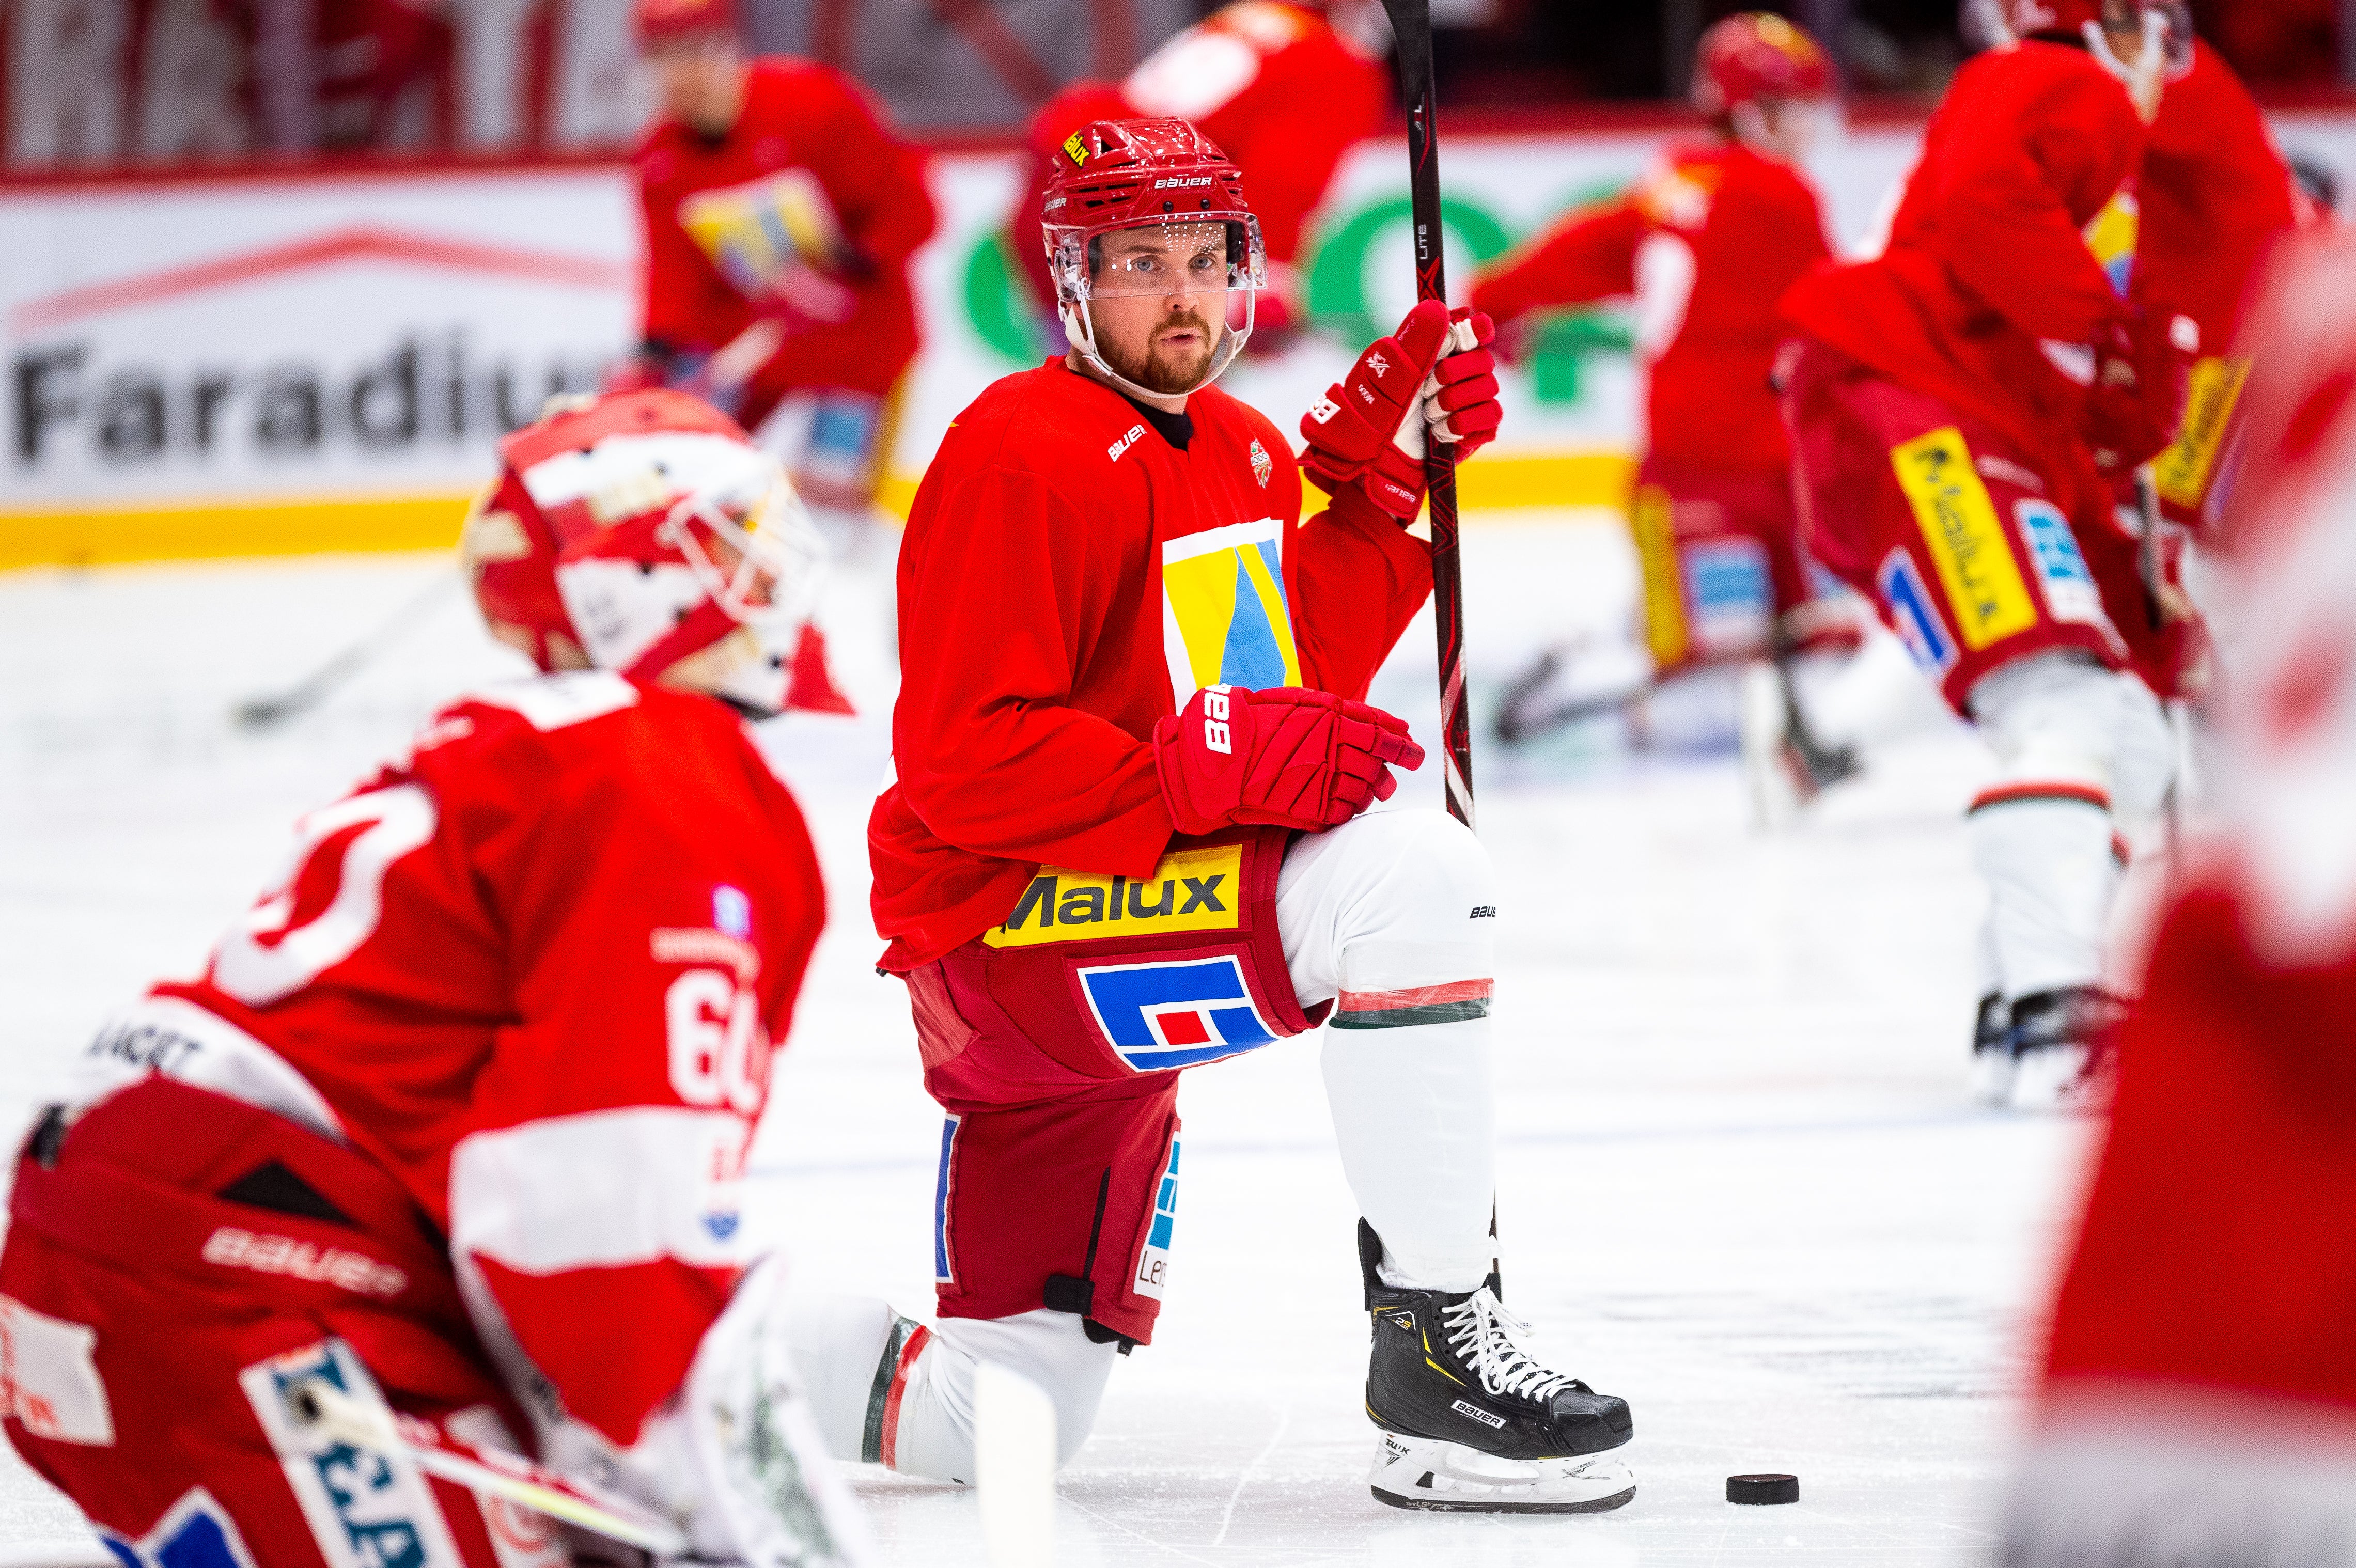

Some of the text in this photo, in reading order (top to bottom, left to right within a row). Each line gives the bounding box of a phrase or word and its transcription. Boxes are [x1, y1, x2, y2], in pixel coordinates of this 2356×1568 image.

[1062, 130, 1090, 167] alux
[1154, 177, 1212, 189] BAUER
[1418, 224, 1428, 259] LITE
[9, 323, 610, 461] Faradiu
[1000, 874, 1227, 935] Malux
[1456, 1403, 1501, 1426] BAUER
